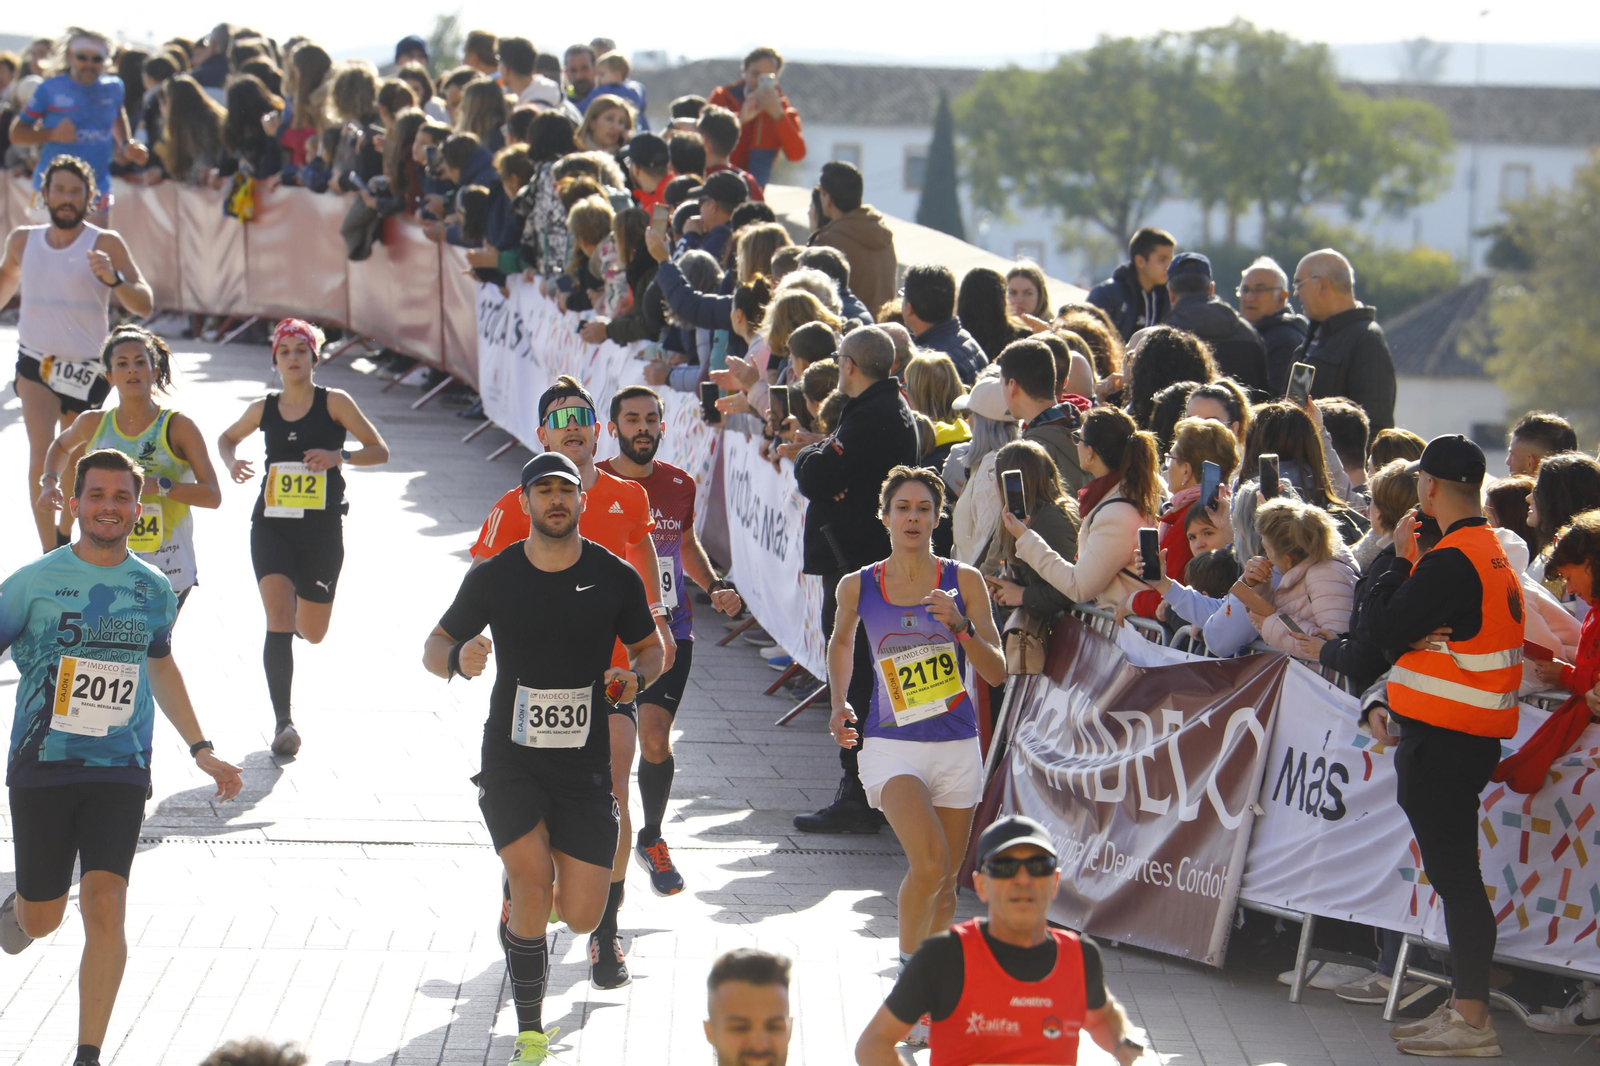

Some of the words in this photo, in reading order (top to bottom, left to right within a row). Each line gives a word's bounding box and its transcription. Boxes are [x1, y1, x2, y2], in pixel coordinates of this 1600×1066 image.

[54, 361, 94, 386] 1045
[281, 475, 317, 494] 912
[650, 508, 663, 518] IA
[655, 516, 681, 530] ATÓN
[134, 516, 159, 536] 84
[651, 533, 665, 541] OBA
[661, 571, 672, 592] 9
[100, 616, 146, 632] Media
[901, 647, 929, 661] IMDECO
[87, 662, 119, 672] IMDECO
[898, 653, 954, 691] 2179
[60, 678, 69, 703] CAJÓN
[72, 673, 134, 705] 2012
[517, 708, 525, 732] CAJÓN
[529, 704, 588, 728] 3630
[1272, 729, 1349, 822] Más
[1101, 840, 1172, 887] Deportes
[1177, 856, 1227, 900] Córdob
